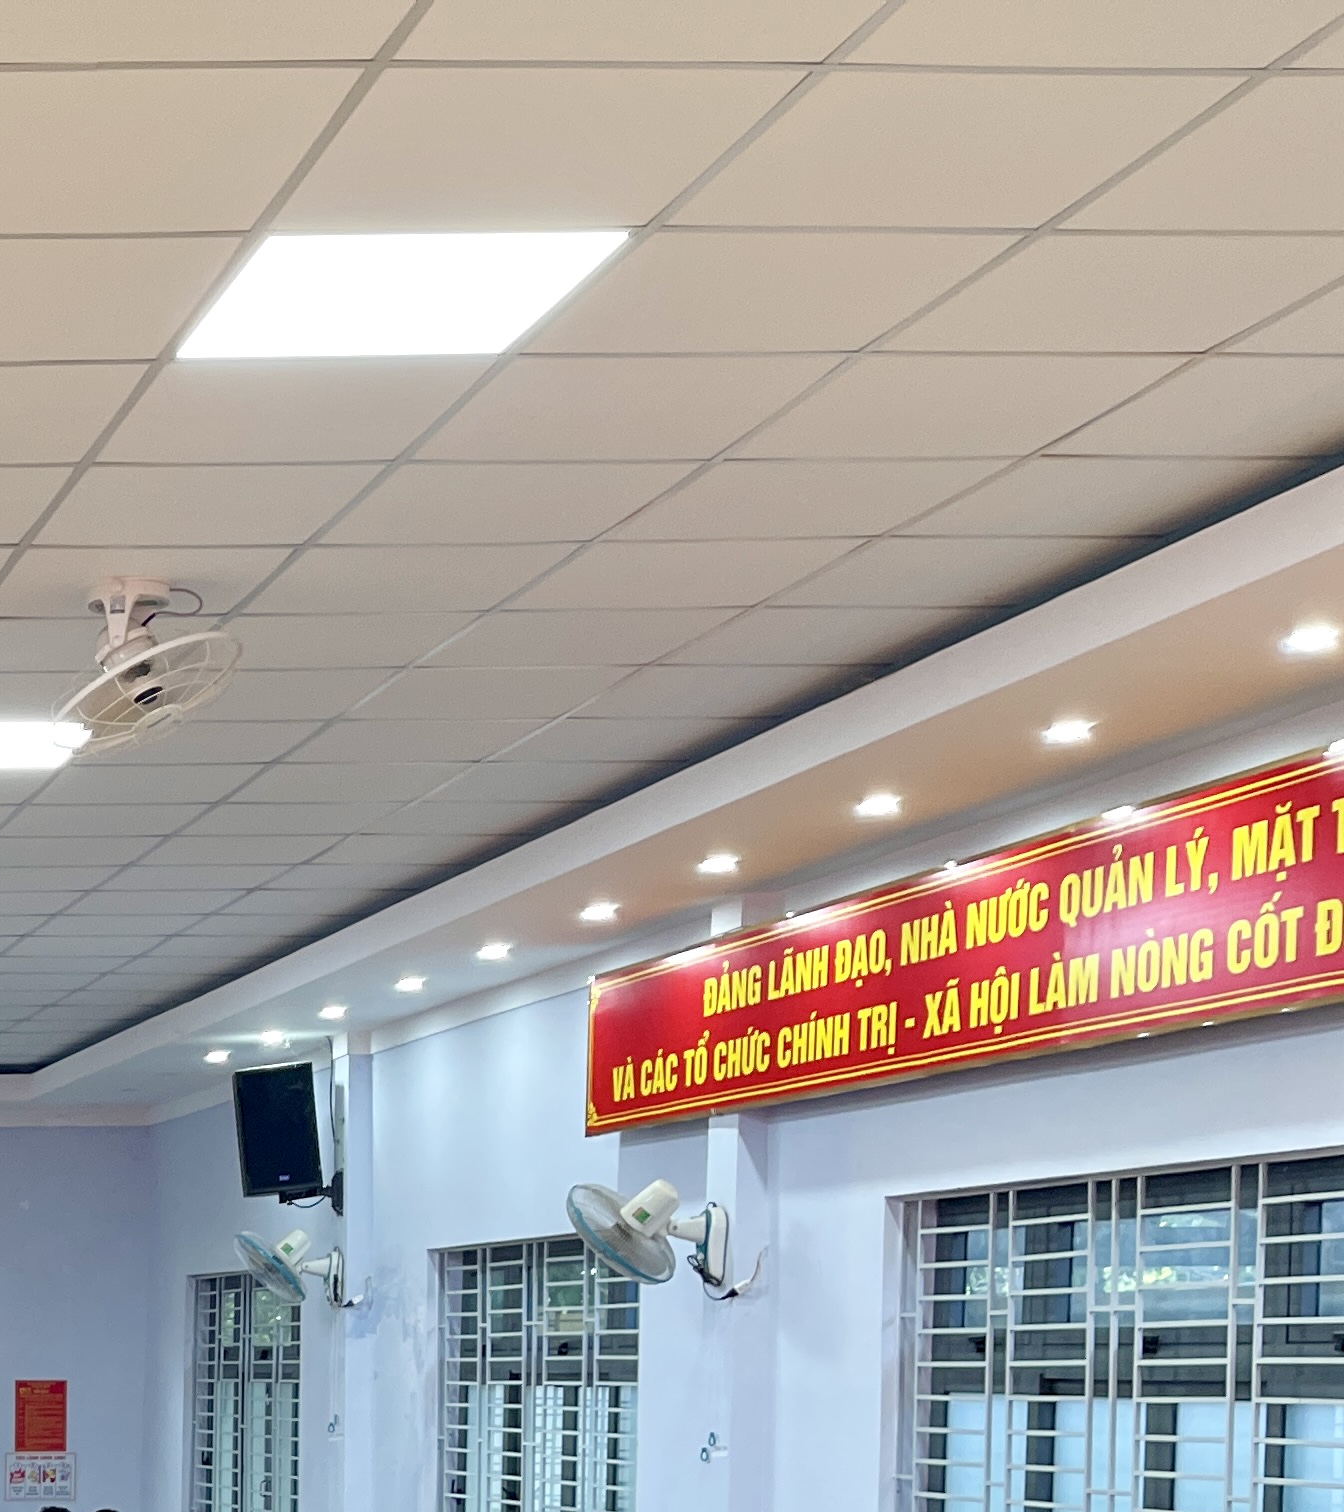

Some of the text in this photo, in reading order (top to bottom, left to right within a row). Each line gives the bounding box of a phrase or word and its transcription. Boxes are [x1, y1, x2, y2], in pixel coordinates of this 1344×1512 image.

[612, 1056, 635, 1102] VÀ
[640, 1048, 678, 1096] CÁC
[683, 1029, 710, 1087] TỔ
[713, 1026, 771, 1081] CHỨC
[777, 1010, 851, 1069] CHÍNH
[857, 1001, 898, 1055] TRỊ
[904, 1017, 916, 1028] -
[922, 977, 961, 1040] XÃ
[969, 965, 1021, 1035] HỘI
[1028, 951, 1099, 1017] LÀM
[1110, 927, 1214, 999] NÒNG
[1226, 891, 1304, 975] CỐT
[703, 960, 761, 1017] ĐẢNG
[768, 947, 829, 1000] LÃNH
[834, 929, 892, 988] ĐẠO,
[900, 900, 958, 966] NHÀ
[965, 878, 1050, 949] NƯỚC
[1059, 844, 1154, 927] QUẢN
[1165, 826, 1219, 894] LÝ,
[1231, 801, 1320, 882] MẶT
